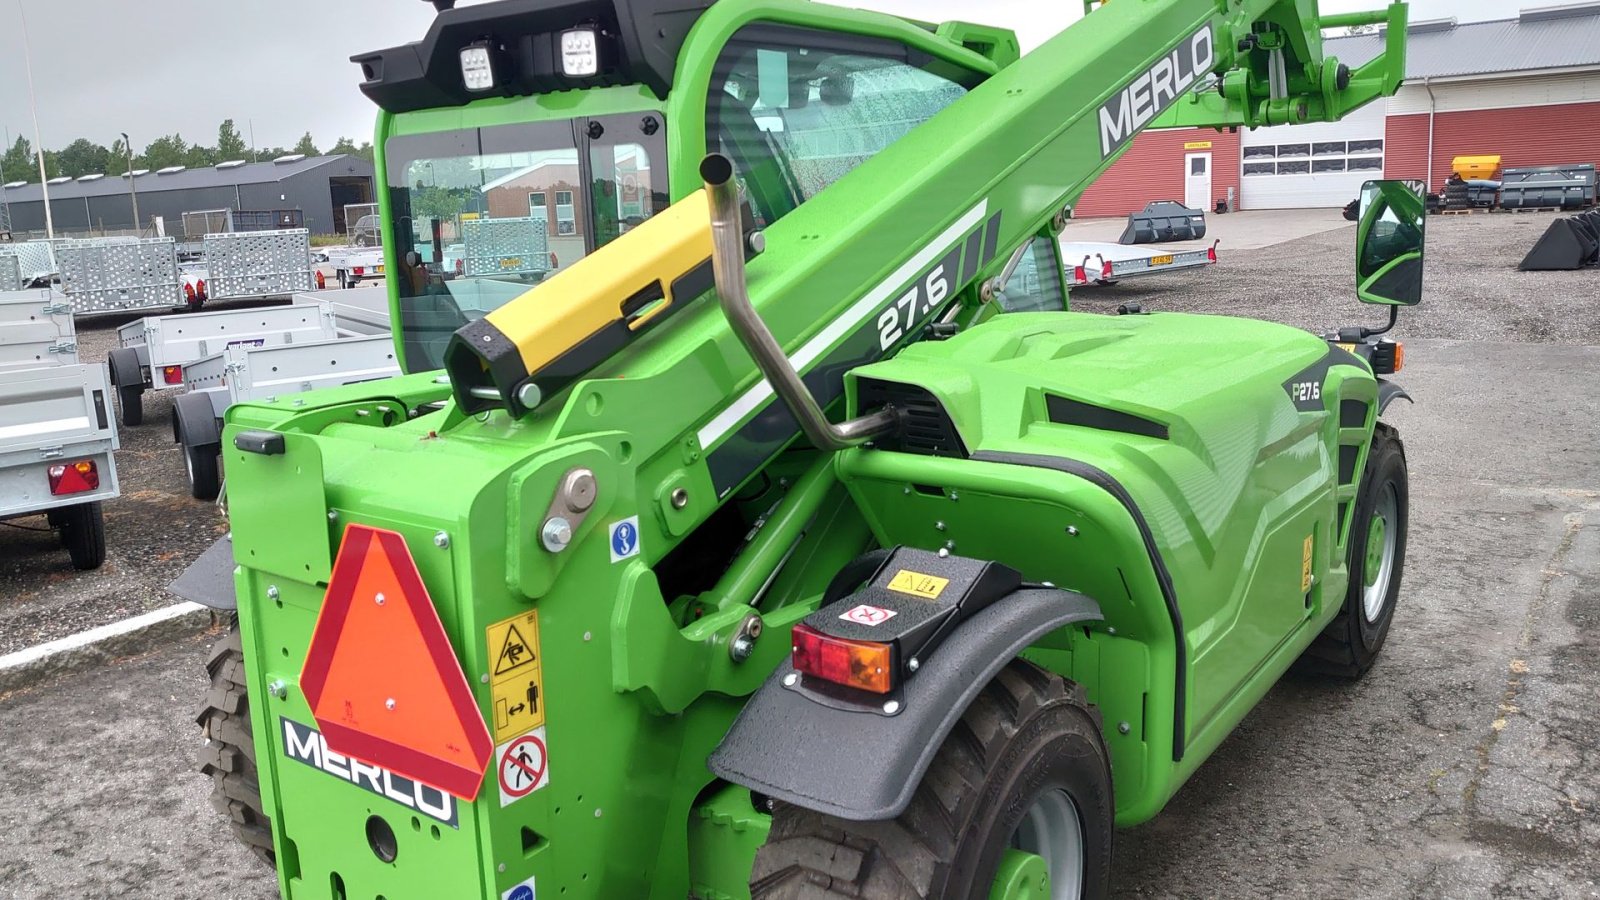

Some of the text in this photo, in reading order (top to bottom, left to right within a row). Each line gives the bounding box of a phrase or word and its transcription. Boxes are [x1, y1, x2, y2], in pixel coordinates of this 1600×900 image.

[1099, 25, 1213, 157] MERLO
[877, 263, 948, 352] 27.6
[1292, 381, 1320, 402] P27.6
[284, 720, 452, 821] MERLO
